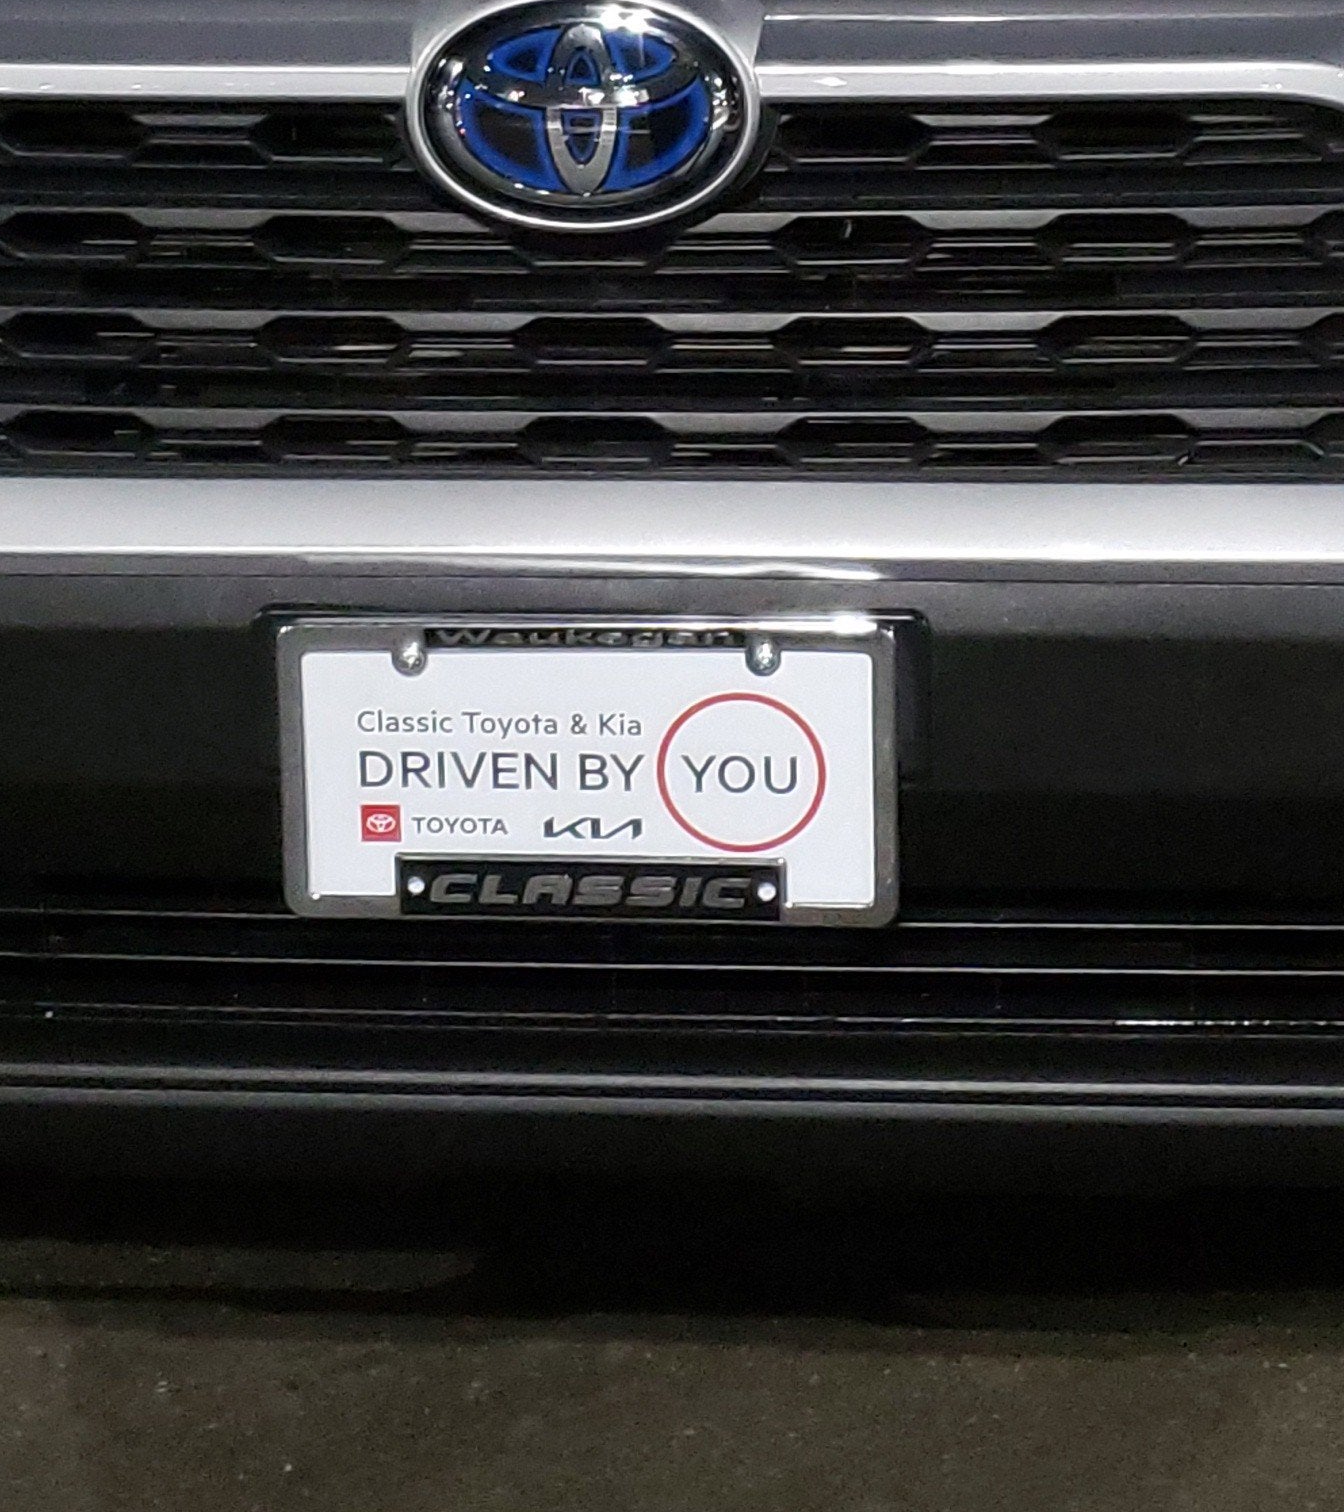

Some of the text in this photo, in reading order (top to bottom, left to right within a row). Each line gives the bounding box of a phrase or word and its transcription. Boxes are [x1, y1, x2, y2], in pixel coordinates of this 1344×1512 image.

[356, 709, 643, 740] Classic Toyota & Kia
[358, 750, 798, 795] DRIVEN BY YOU
[411, 816, 508, 836] TOYOTA
[428, 873, 752, 909] CLASSIC
